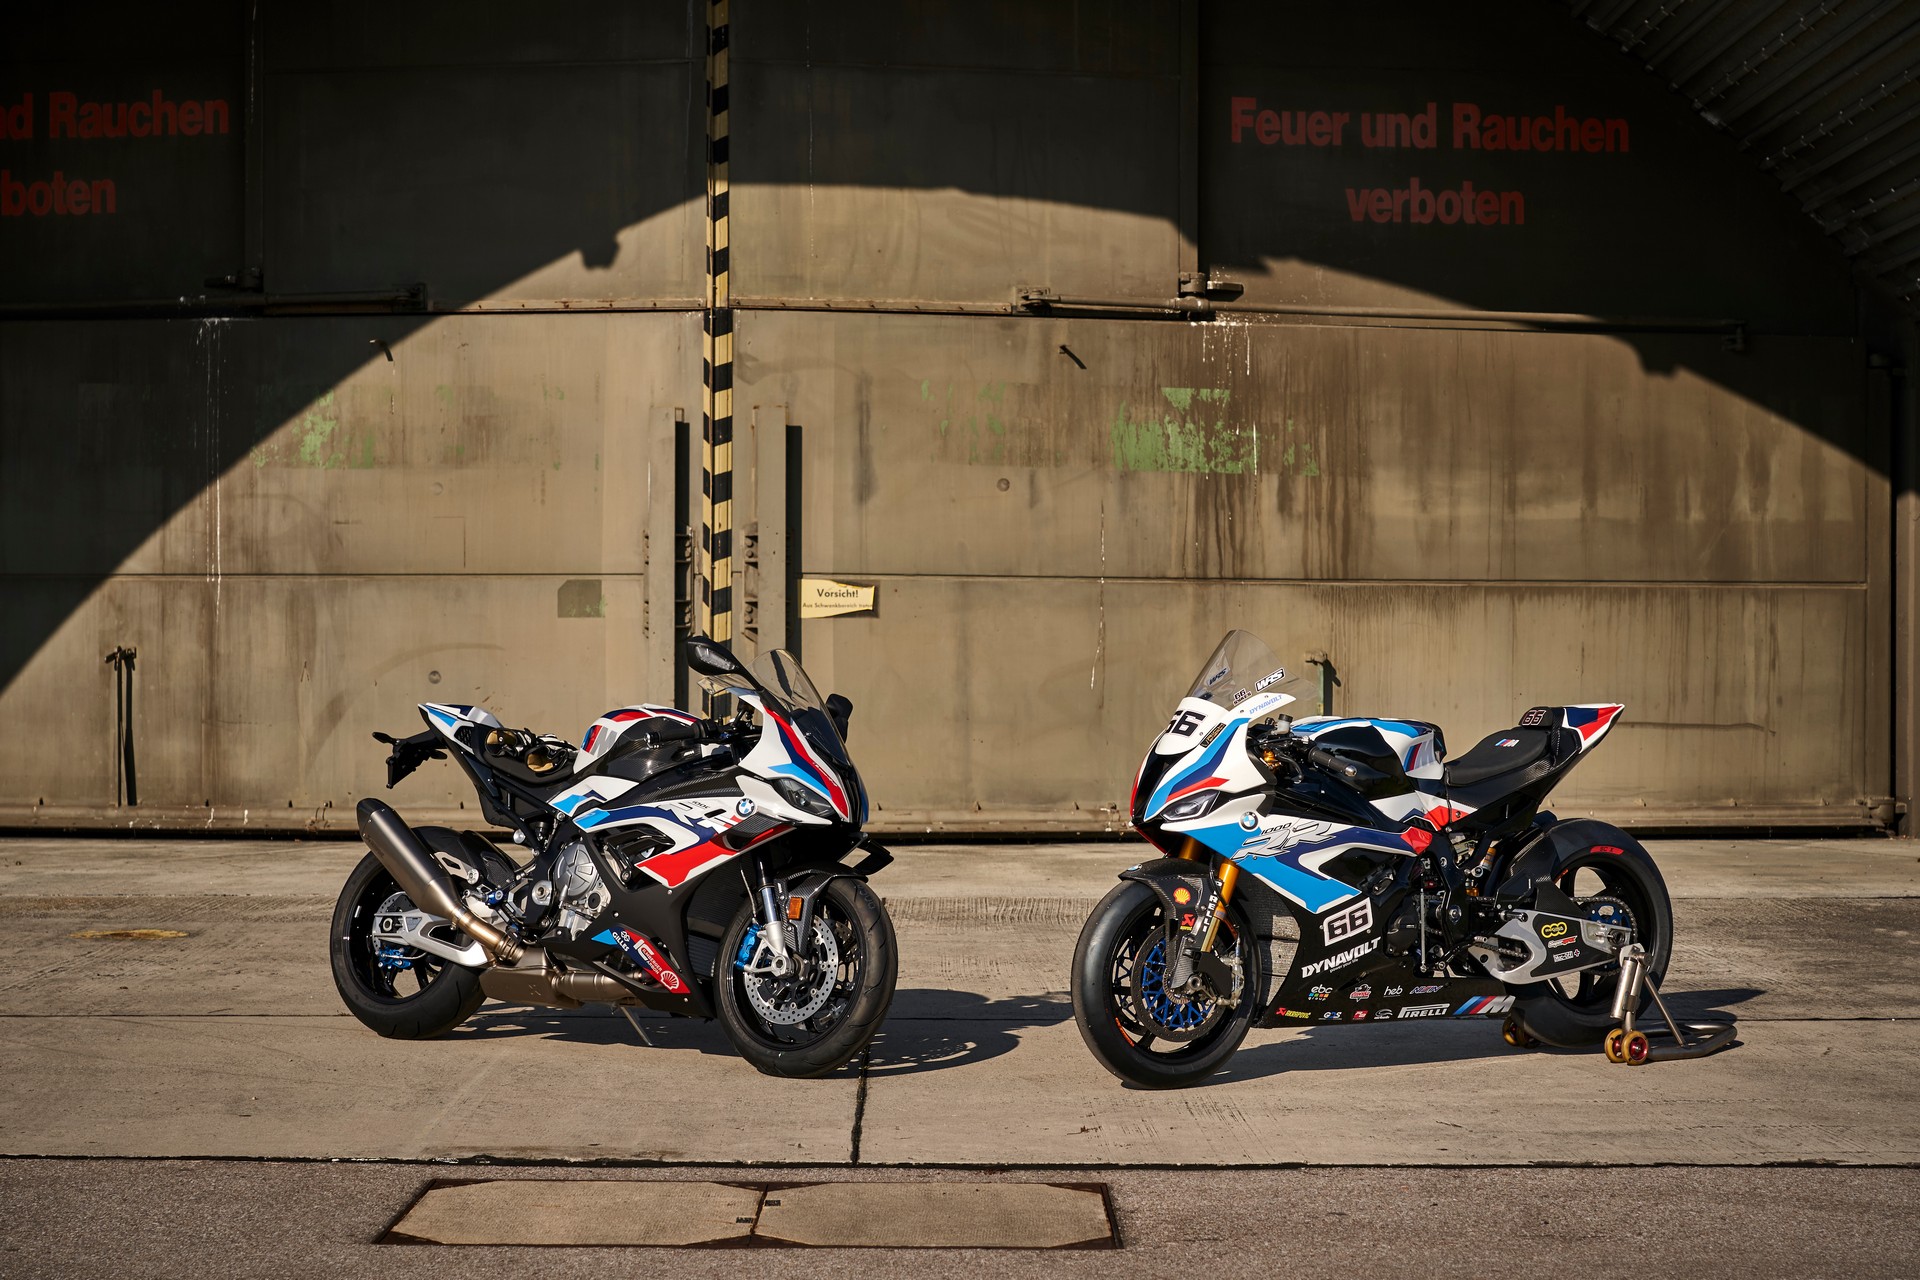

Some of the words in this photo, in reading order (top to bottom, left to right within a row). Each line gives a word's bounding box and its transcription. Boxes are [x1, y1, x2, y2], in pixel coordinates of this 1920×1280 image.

[49, 89, 229, 138] Rauchen
[1231, 97, 1349, 146] Feuer
[1361, 102, 1437, 148] und
[1453, 102, 1629, 152] Rauchen
[1345, 177, 1525, 224] verboten
[817, 588, 859, 598] Vorsicht!
[1256, 668, 1284, 691] WRS
[1234, 689, 1246, 701] 66
[1249, 694, 1283, 715] DYNAVOLT
[1521, 709, 1547, 726] 66
[1261, 823, 1293, 835] 1000
[1328, 904, 1369, 941] 66
[612, 931, 630, 952] GILLES
[1301, 936, 1382, 979] DYNAVOLT
[1311, 984, 1333, 994] ebc
[1383, 985, 1403, 997] heb
[1397, 1003, 1451, 1019] PIRELLI
